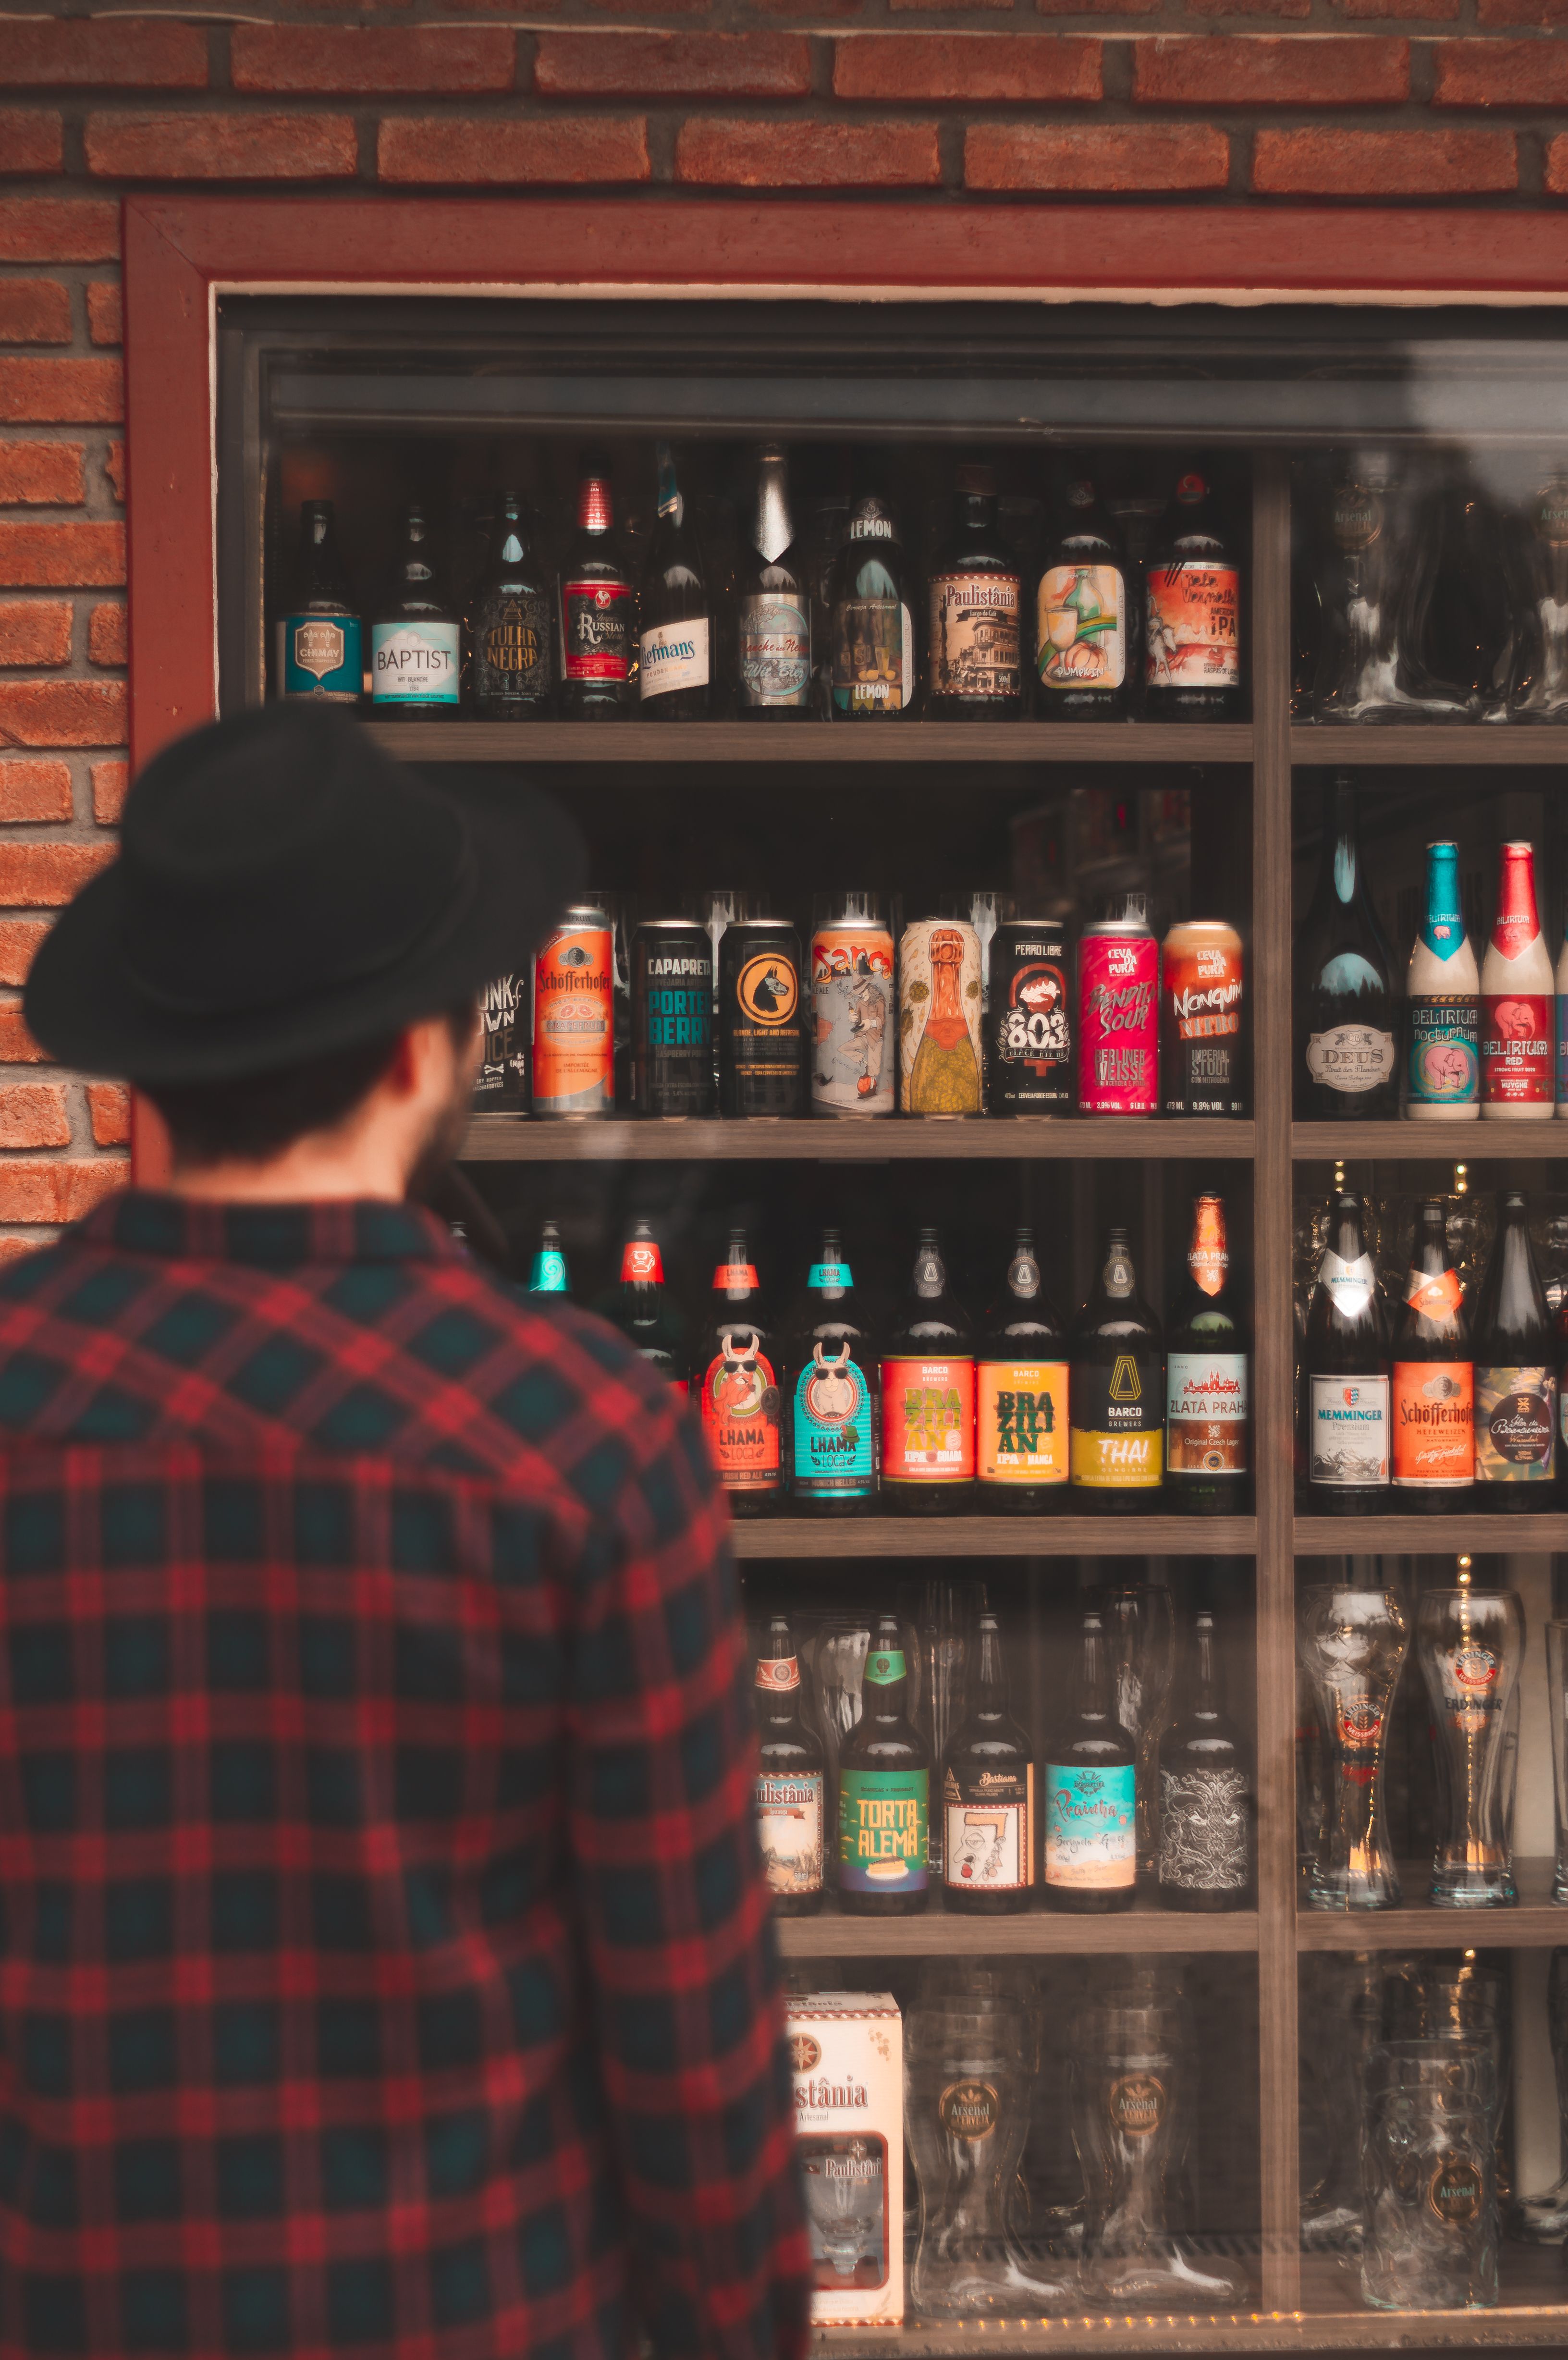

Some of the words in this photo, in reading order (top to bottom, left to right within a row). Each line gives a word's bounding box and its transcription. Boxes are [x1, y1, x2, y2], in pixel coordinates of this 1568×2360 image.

[1335, 510, 1372, 523] Arsenal
[850, 519, 892, 540] LEMON
[945, 584, 1016, 609] Paulistânia
[970, 610, 981, 618] Largo
[487, 626, 538, 646] TULHA
[299, 648, 340, 658] CHIMAY
[378, 649, 452, 671] BAPTIST
[487, 647, 538, 671] NEGRA
[855, 684, 890, 700] LEMON
[1015, 945, 1042, 955] PERRO
[1043, 945, 1062, 956] LIBRE
[1108, 948, 1132, 959] CEVA
[1197, 950, 1223, 961] CEVA
[648, 959, 711, 976] CAPAPRETA
[1109, 963, 1135, 974] PURA
[1198, 964, 1225, 976] PURA
[539, 969, 611, 993] Schöfferhofer
[649, 990, 711, 1015] PORTER
[1097, 1004, 1149, 1042] SOUR
[1413, 1010, 1478, 1024] DELIRIUM
[547, 1021, 605, 1030] GRAPEFRUIT
[649, 1017, 711, 1045] BERRY
[1180, 1013, 1238, 1039] NITRO
[1009, 1048, 1035, 1057] BLACK
[1039, 1049, 1054, 1057] RYE
[1192, 1049, 1228, 1060] IMPERIAL
[1483, 1041, 1548, 1056] DELIRIUM
[1095, 1049, 1146, 1064] BERLINER
[1321, 1049, 1384, 1064] DEUS
[1505, 1057, 1523, 1066] RED
[1095, 1061, 1144, 1081] WEISSE
[1191, 1058, 1230, 1076] STOUT
[819, 1268, 840, 1277] LHAMA
[1331, 1277, 1368, 1285] MEMMINGER
[904, 1388, 962, 1408] BRA
[997, 1391, 1054, 1411] BRA
[904, 1408, 962, 1431] ZILI
[1108, 1407, 1142, 1417] BARCO
[1318, 1409, 1383, 1421] MEMMINGER
[997, 1411, 1054, 1434] ZILI
[719, 1428, 765, 1445] LHAMA
[904, 1430, 948, 1451] AN
[997, 1433, 1039, 1453] AN
[1184, 1438, 1208, 1446] Original
[810, 1436, 857, 1453] LHAMA
[1098, 1438, 1149, 1464] THAI
[904, 1450, 927, 1463] IPA
[937, 1450, 962, 1463] GOIABA
[997, 1453, 1019, 1465] IPA
[1028, 1454, 1053, 1465] MANGA
[1345, 1703, 1381, 1718] ERDINGER
[755, 1781, 814, 1804] ulistânia
[1053, 1789, 1117, 1822] Prainha
[856, 1799, 919, 1829] TORTA
[795, 2074, 869, 2109] stânia
[951, 2103, 990, 2115] Arsenal
[1118, 2097, 1158, 2110] Arsenal
[799, 2111, 829, 2122] Artesanal
[1441, 2184, 1475, 2198] Arsenal
